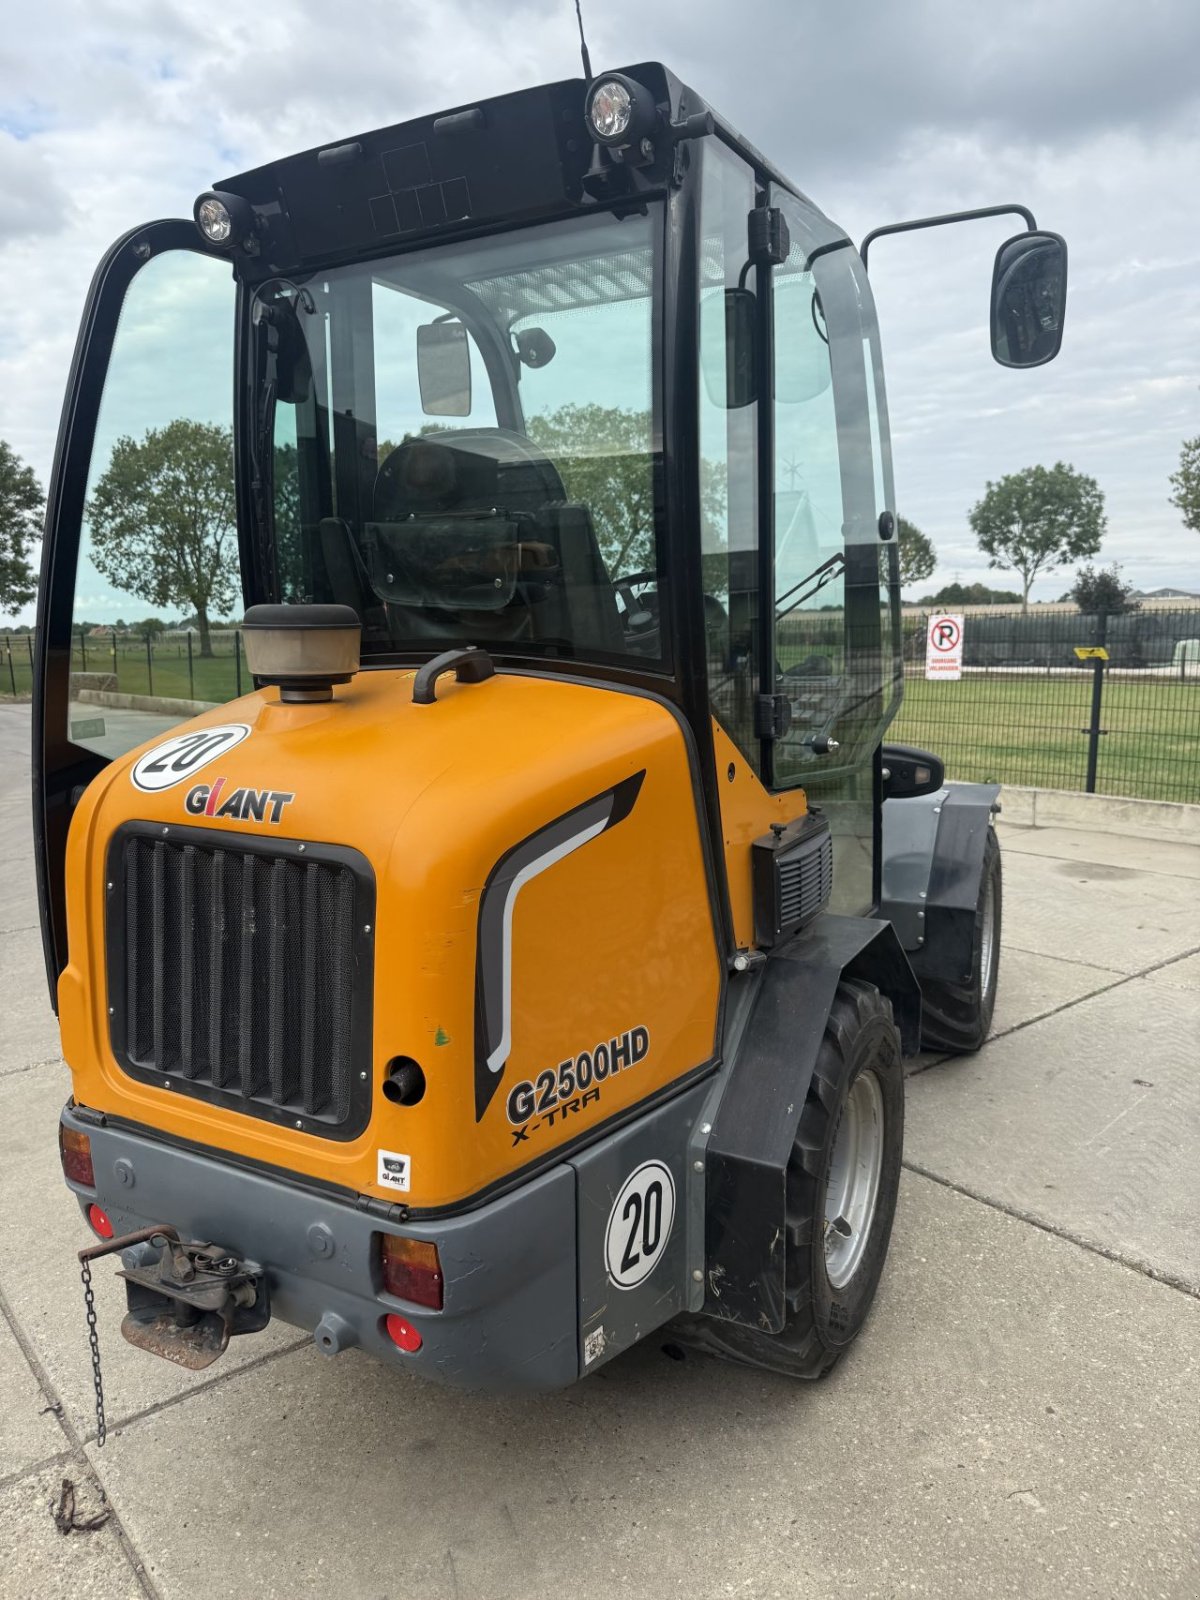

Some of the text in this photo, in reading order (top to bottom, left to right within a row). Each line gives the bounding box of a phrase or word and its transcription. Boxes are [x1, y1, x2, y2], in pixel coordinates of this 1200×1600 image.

[142, 732, 235, 774] 20
[184, 777, 295, 825] GIANT
[506, 1025, 650, 1126] G2500HD
[511, 1087, 601, 1148] X-TRA
[620, 1180, 663, 1275] 20
